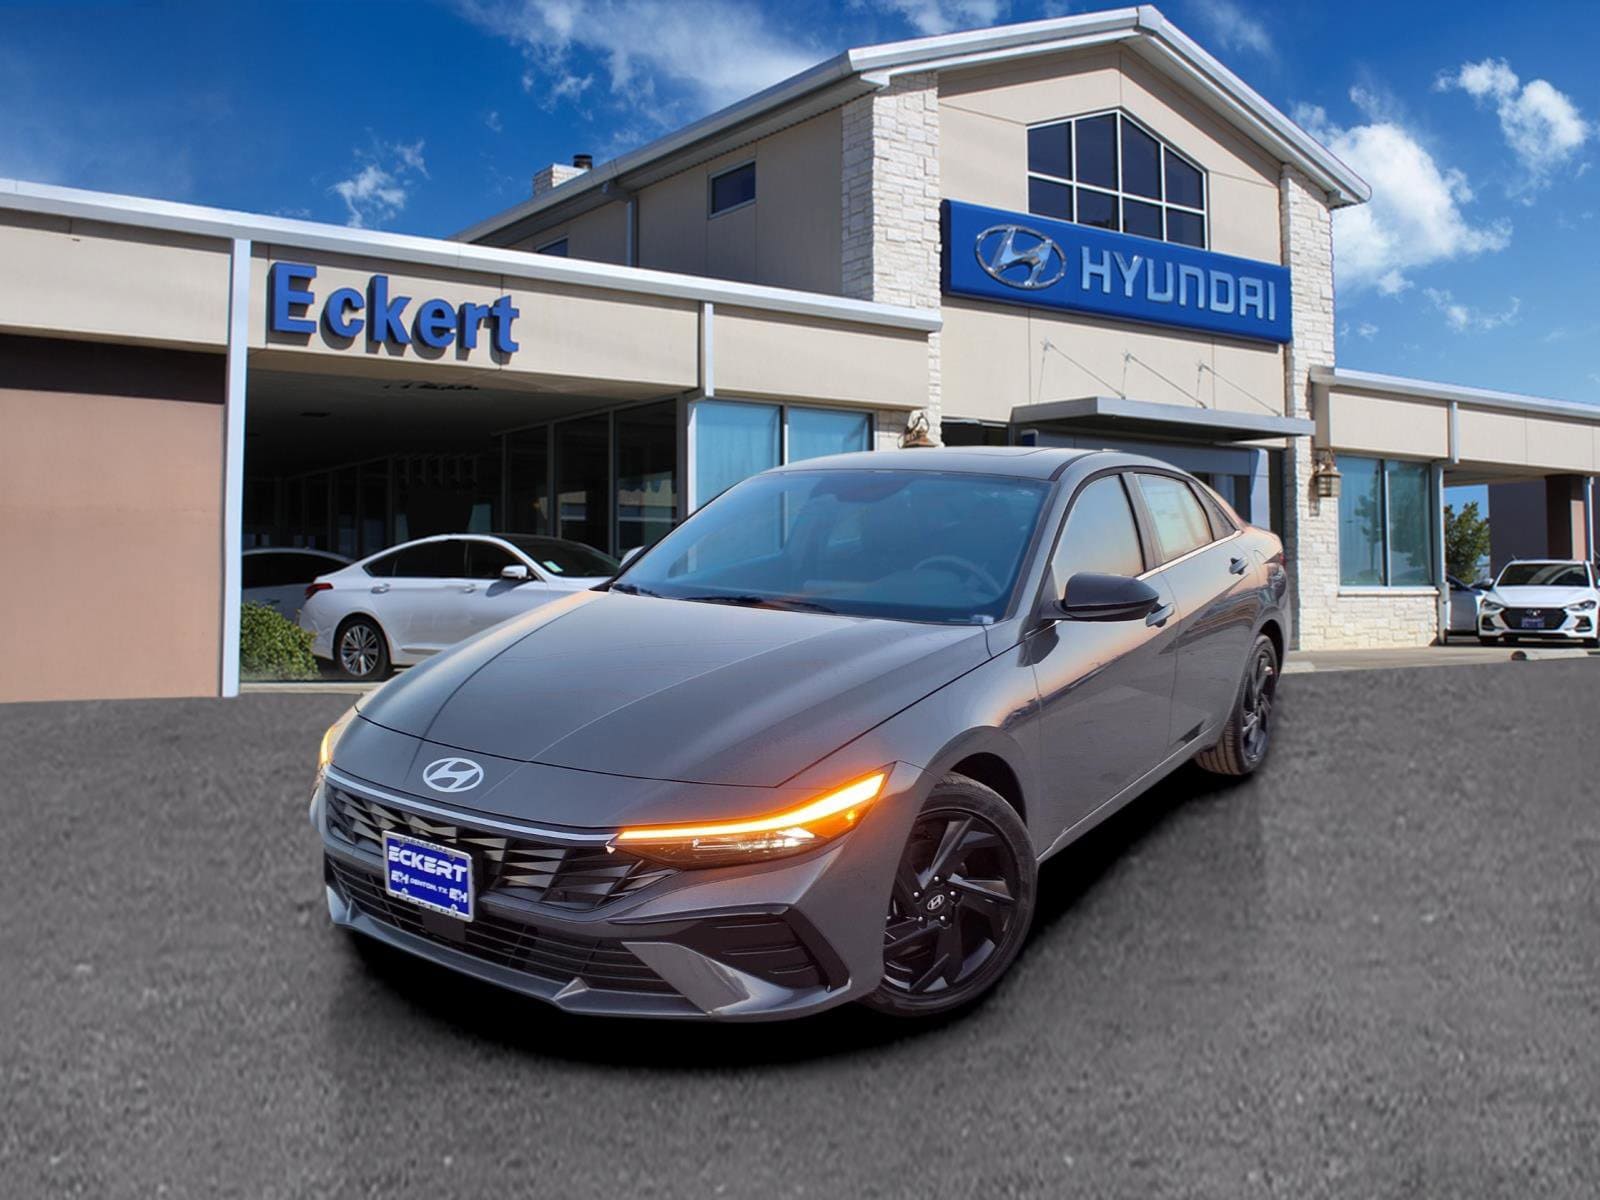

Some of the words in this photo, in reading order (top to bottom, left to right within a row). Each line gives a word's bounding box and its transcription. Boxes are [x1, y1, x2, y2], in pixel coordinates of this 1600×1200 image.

[269, 262, 520, 353] Eckert
[1081, 246, 1276, 321] HYUNDAI
[388, 845, 467, 882] ECKERT
